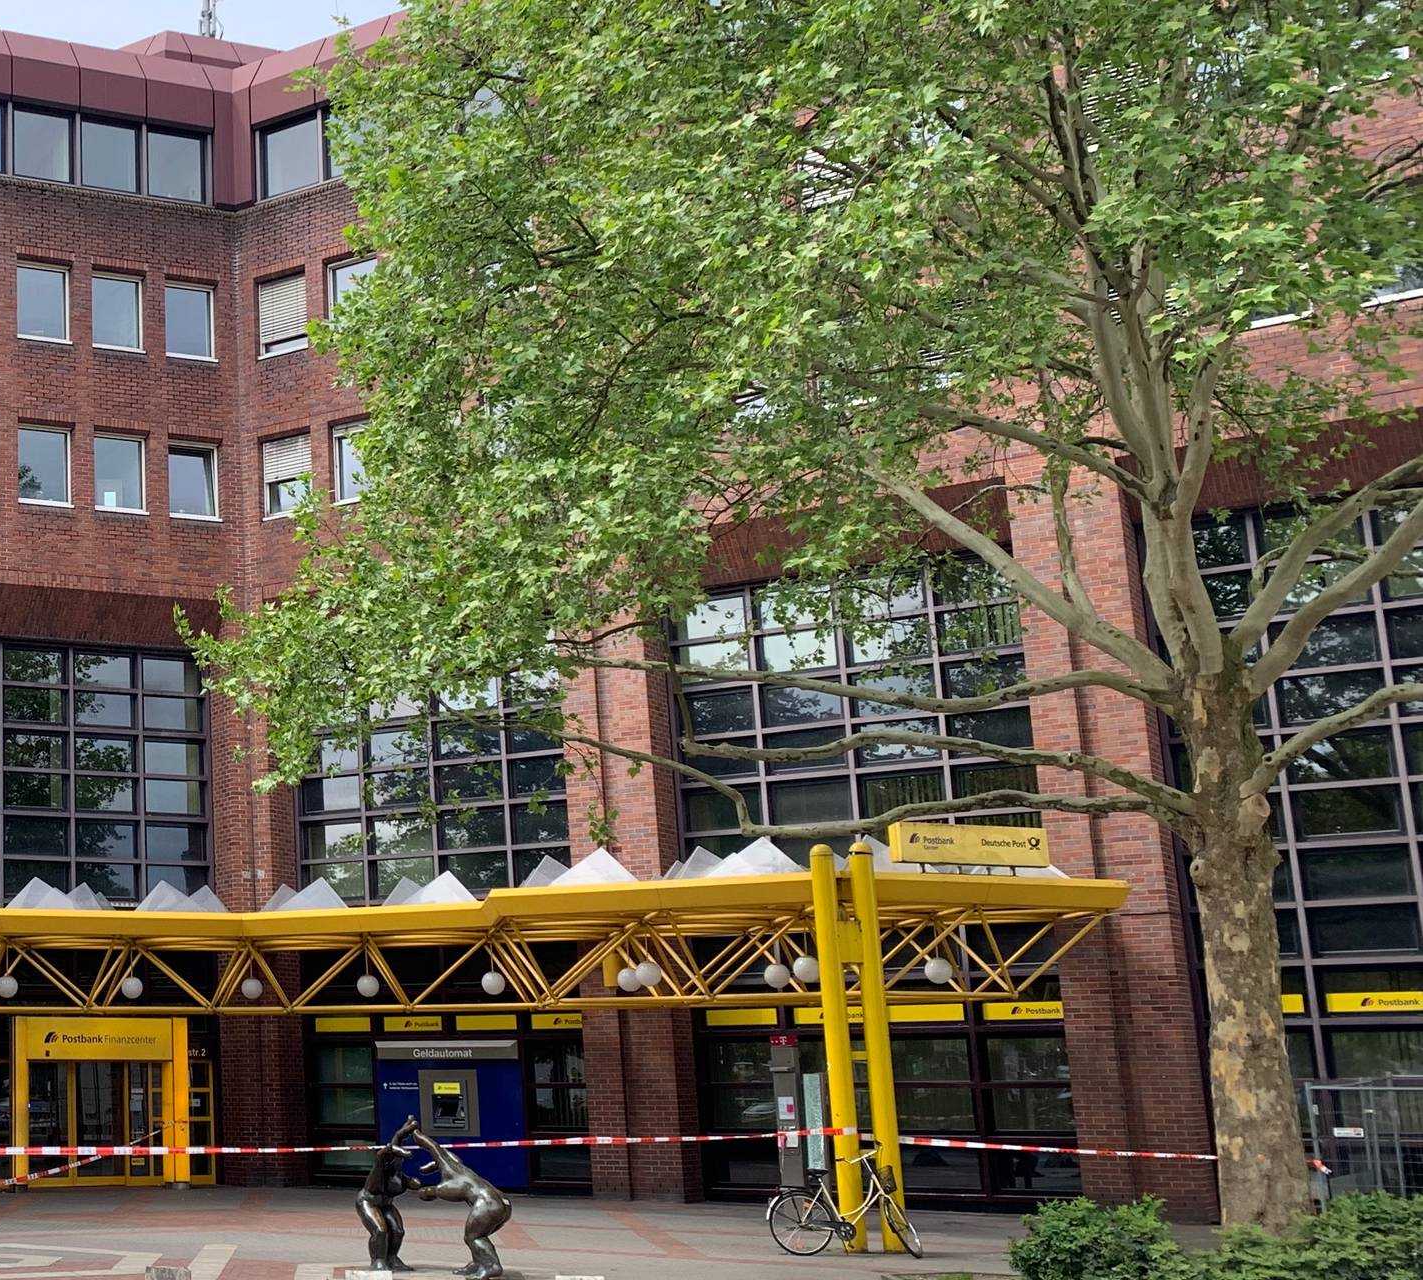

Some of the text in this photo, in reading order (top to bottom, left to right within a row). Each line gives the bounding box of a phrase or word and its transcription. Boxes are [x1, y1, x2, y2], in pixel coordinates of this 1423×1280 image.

[923, 835, 954, 845] Postbank
[981, 838, 1027, 848] Deutsche Post
[1378, 998, 1421, 1006] Postbank
[1025, 1006, 1061, 1015] Postbank
[62, 1033, 157, 1045] Postbank Finanzcenter
[412, 1048, 473, 1059] Geldautomat
